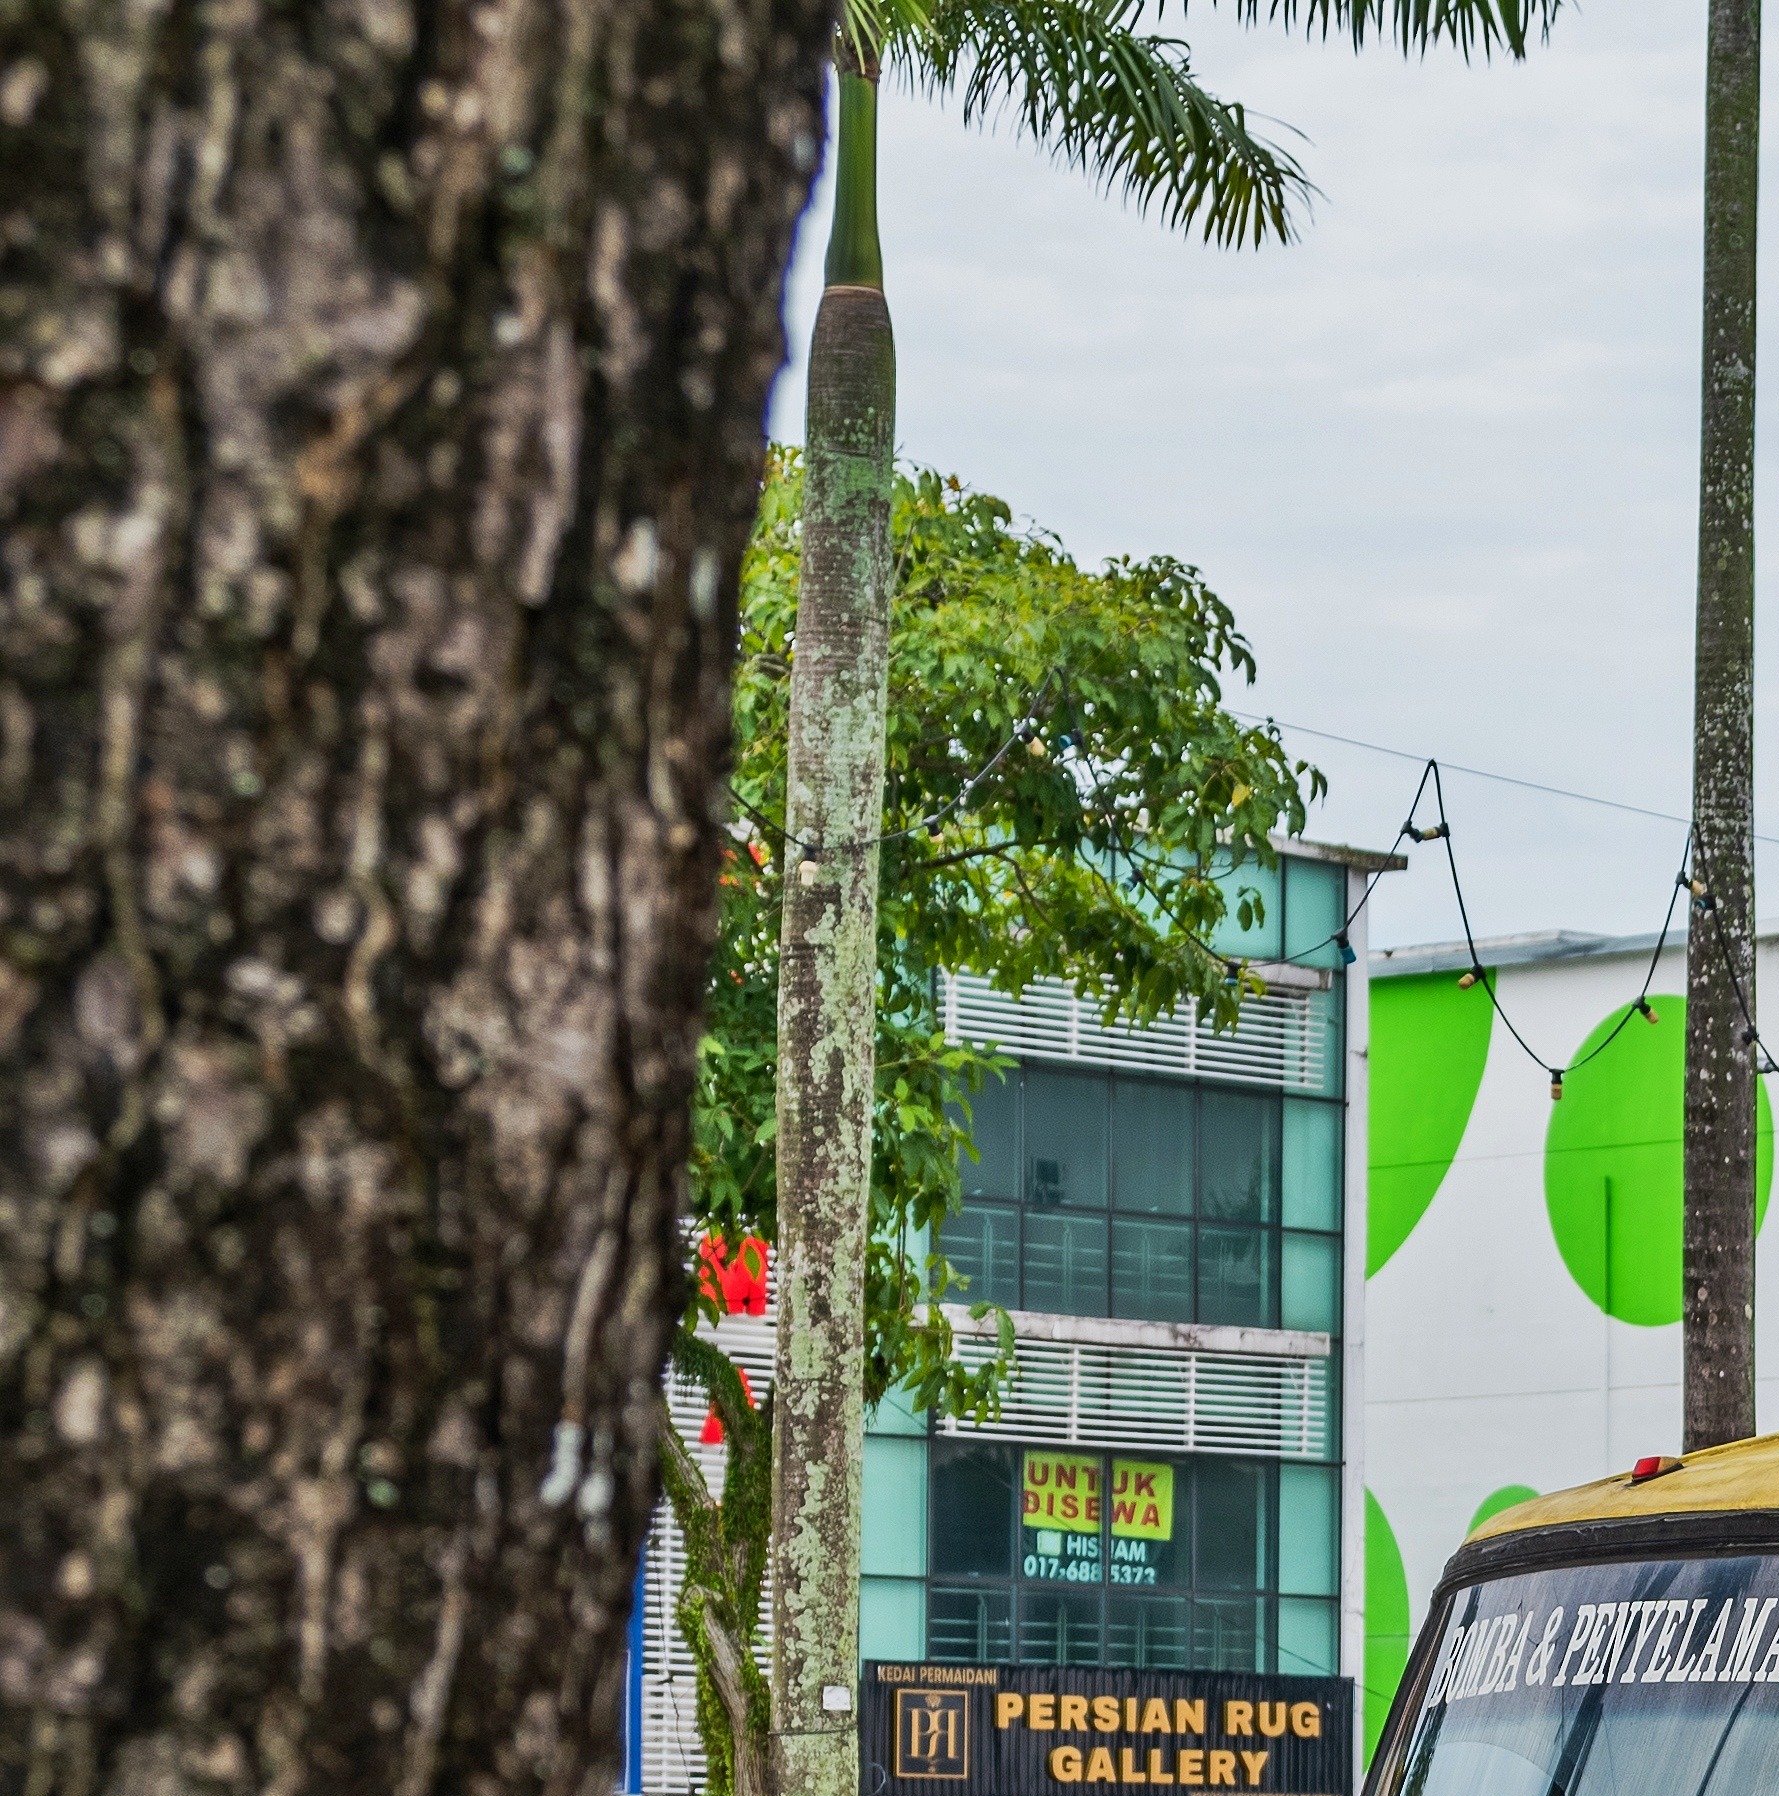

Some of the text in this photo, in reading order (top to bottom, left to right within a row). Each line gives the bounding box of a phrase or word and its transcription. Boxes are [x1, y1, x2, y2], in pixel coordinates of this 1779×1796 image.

[1027, 1459, 1157, 1498] UNTUK
[1023, 1490, 1161, 1528] DISEWA
[1066, 1533, 1147, 1563] HISAM
[878, 1666, 998, 1685] KEDAI PERMAIDANI
[1428, 1616, 1530, 1707] BOMBA
[1525, 1605, 1563, 1687] &
[997, 1692, 1321, 1738] PERSIAN RUG
[1051, 1745, 1269, 1786] GALLERY
